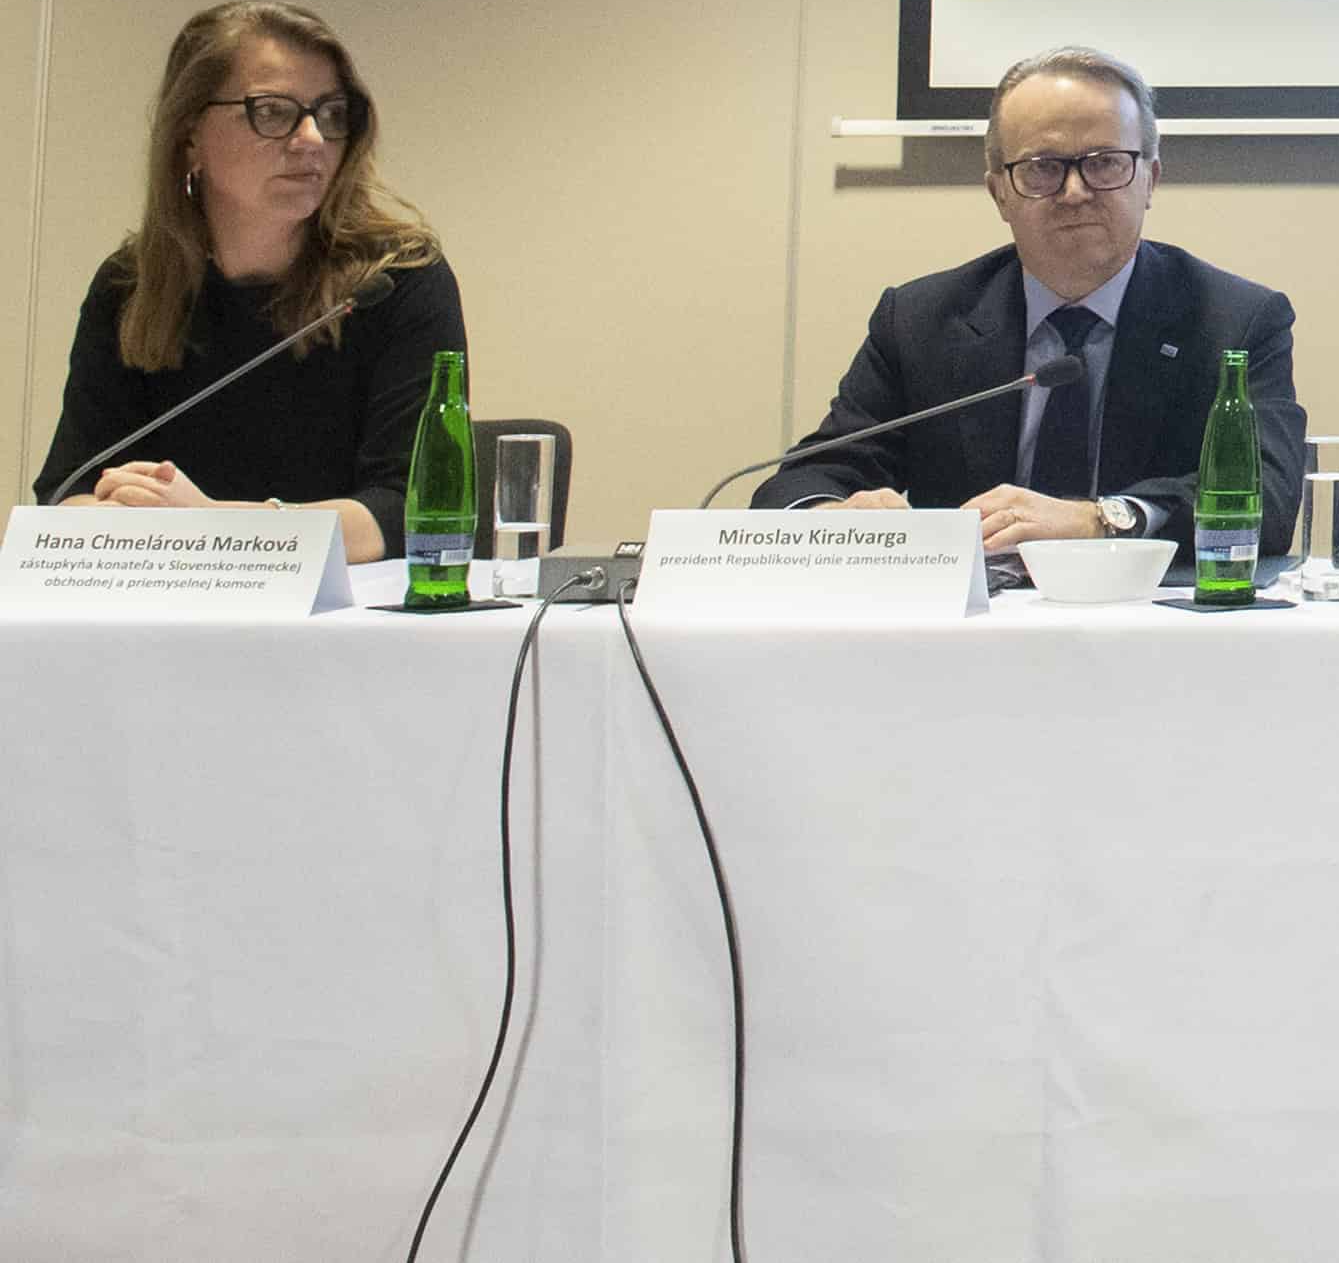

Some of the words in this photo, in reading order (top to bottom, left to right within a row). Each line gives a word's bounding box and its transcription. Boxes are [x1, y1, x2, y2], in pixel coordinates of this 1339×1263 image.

[34, 533, 85, 549] Hana
[91, 533, 207, 551] Chmelárová
[212, 535, 299, 552] Marková
[718, 528, 803, 545] Miroslav
[808, 528, 908, 548] Kiraľvarga
[158, 562, 166, 570] v
[168, 559, 302, 574] Slovensko-nemeckej
[660, 554, 723, 566] prezident
[726, 554, 811, 568] Republikovej
[44, 577, 114, 589] obchodnej
[127, 578, 212, 590] priemyselnej
[215, 578, 265, 589] komore
